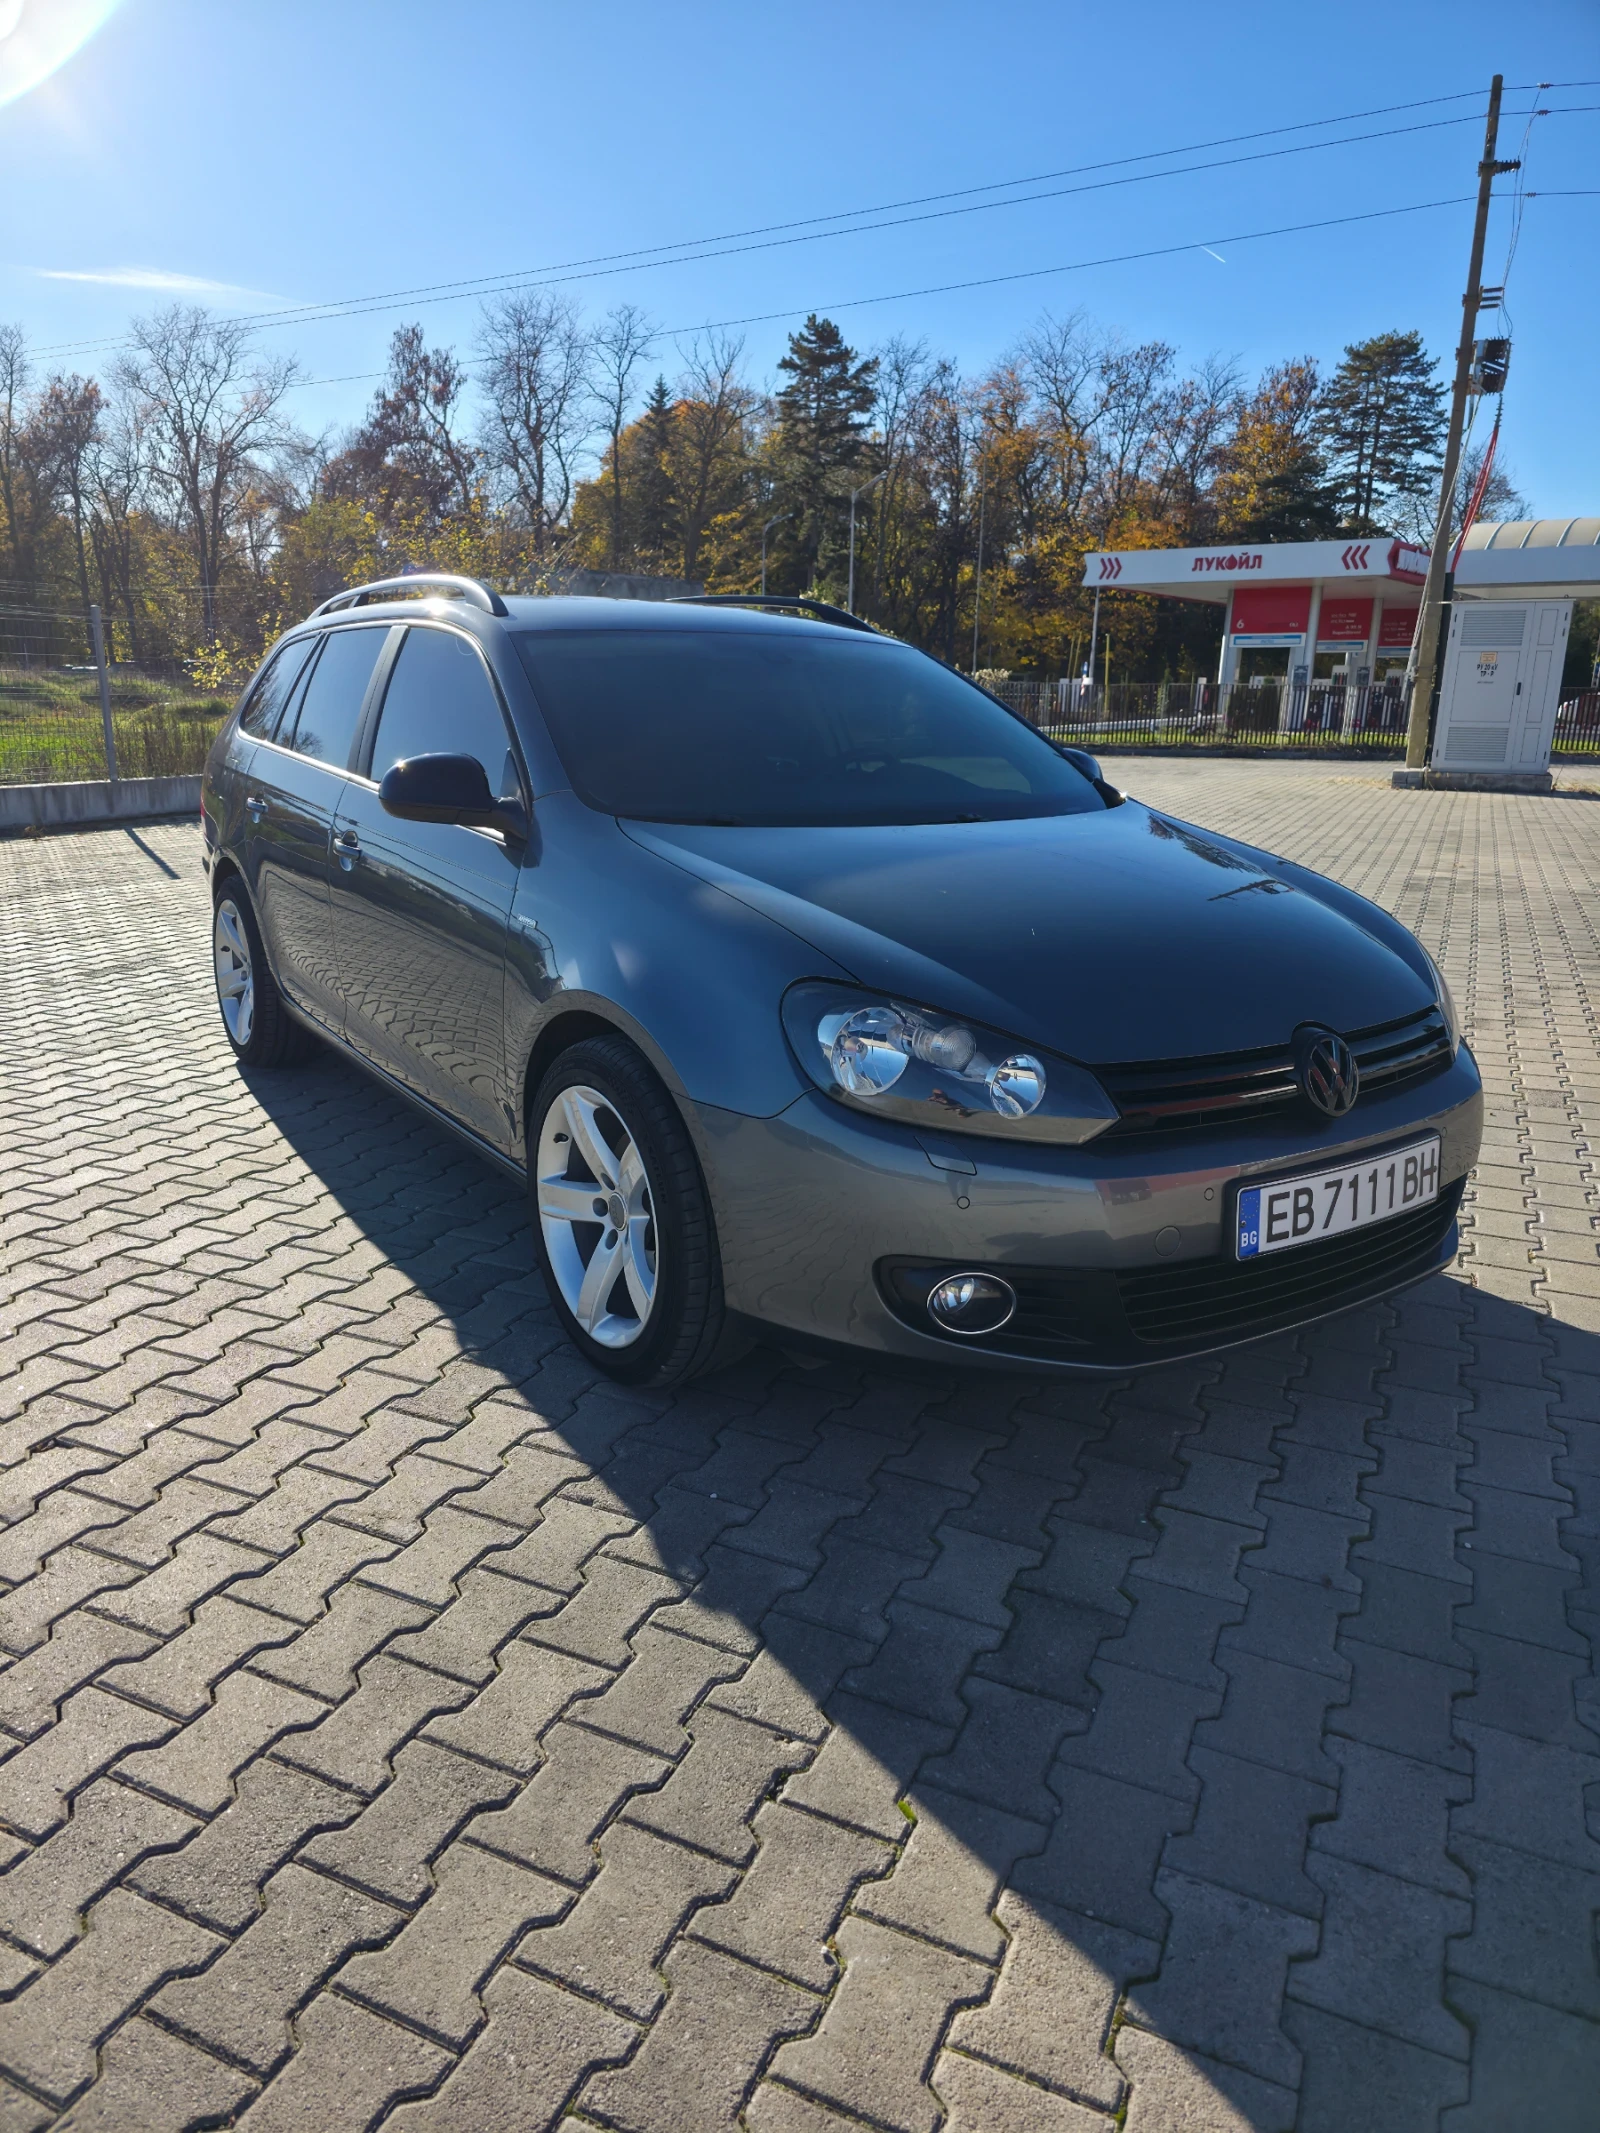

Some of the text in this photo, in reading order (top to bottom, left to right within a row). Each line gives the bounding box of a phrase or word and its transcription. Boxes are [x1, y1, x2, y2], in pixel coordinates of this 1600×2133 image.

[1192, 552, 1262, 571] ЛУКОЙЛ
[1236, 619, 1244, 629] 6
[1240, 1230, 1258, 1248] BG
